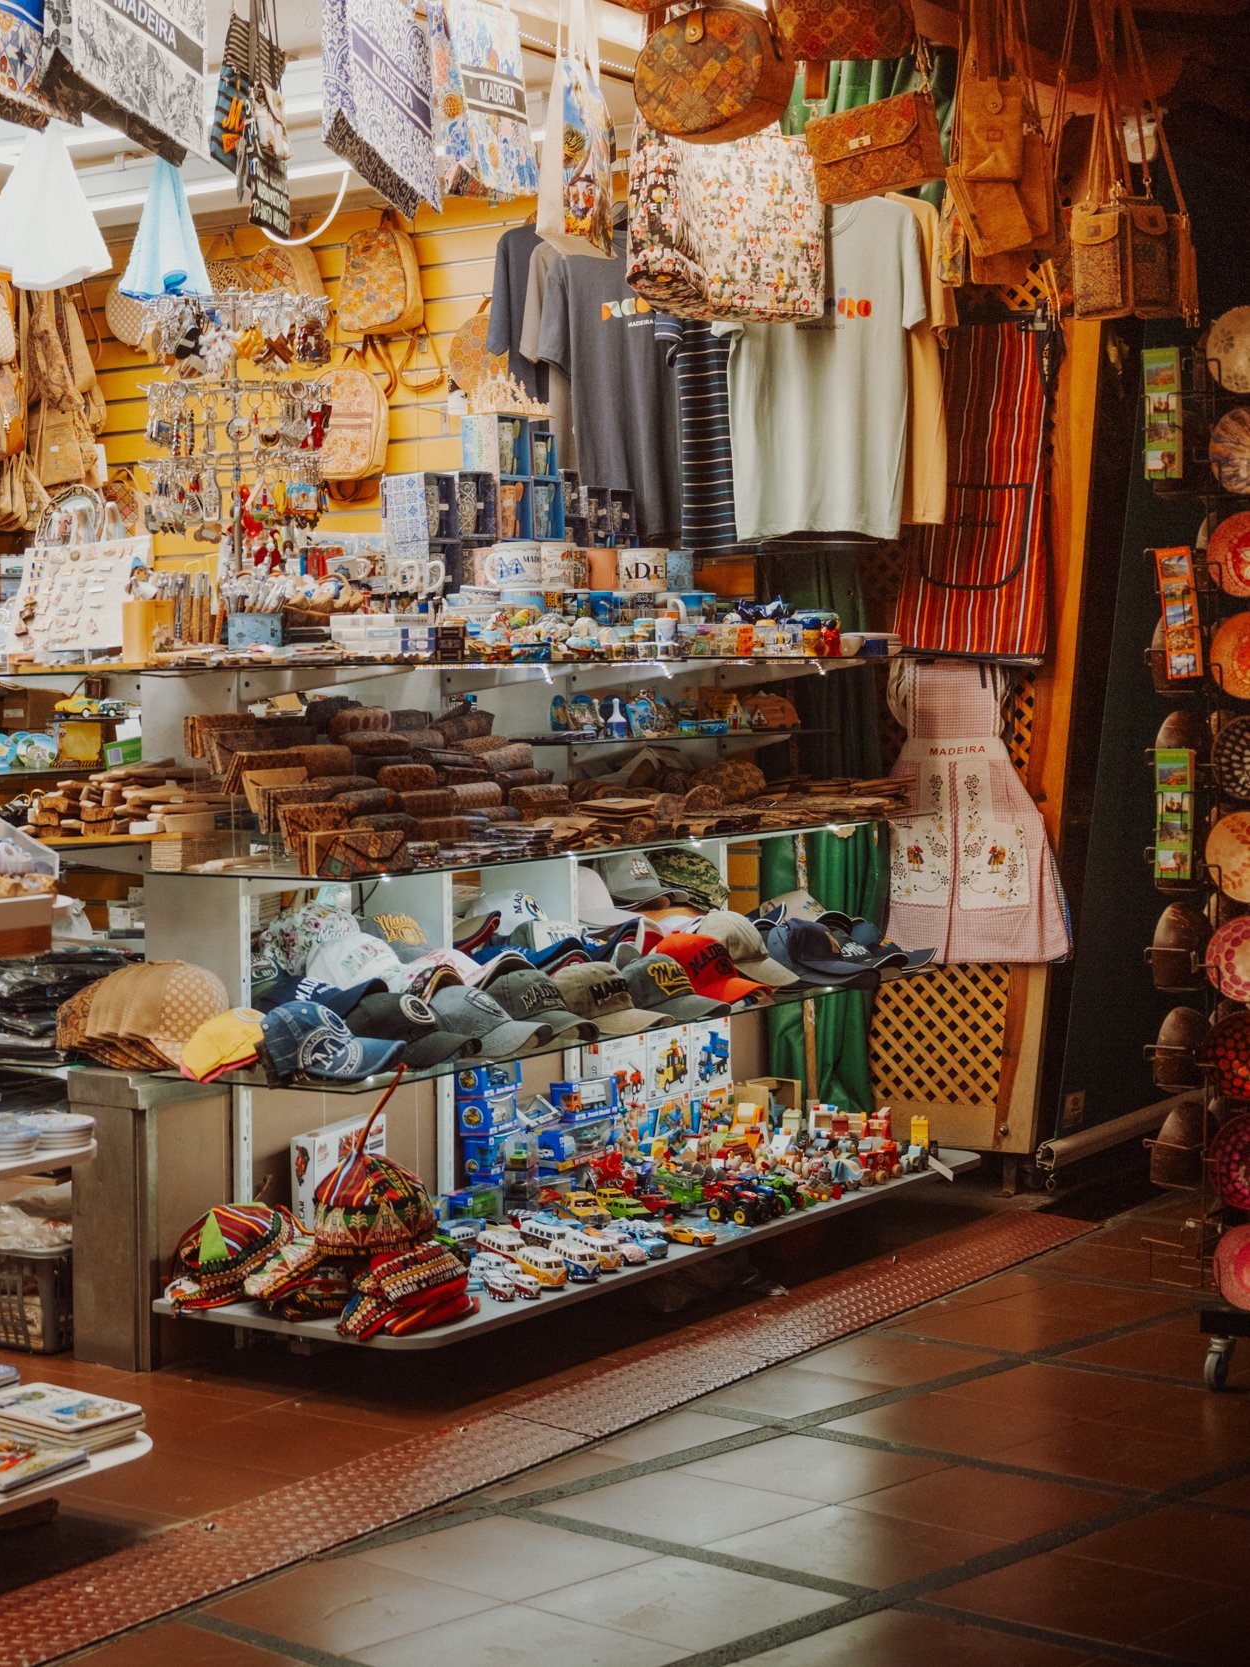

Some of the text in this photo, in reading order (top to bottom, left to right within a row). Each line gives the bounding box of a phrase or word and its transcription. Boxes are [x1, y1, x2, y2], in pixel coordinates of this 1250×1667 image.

[372, 53, 413, 109] MADEIRA
[479, 80, 516, 107] MADEIRA
[929, 745, 986, 756] MADEIRA
